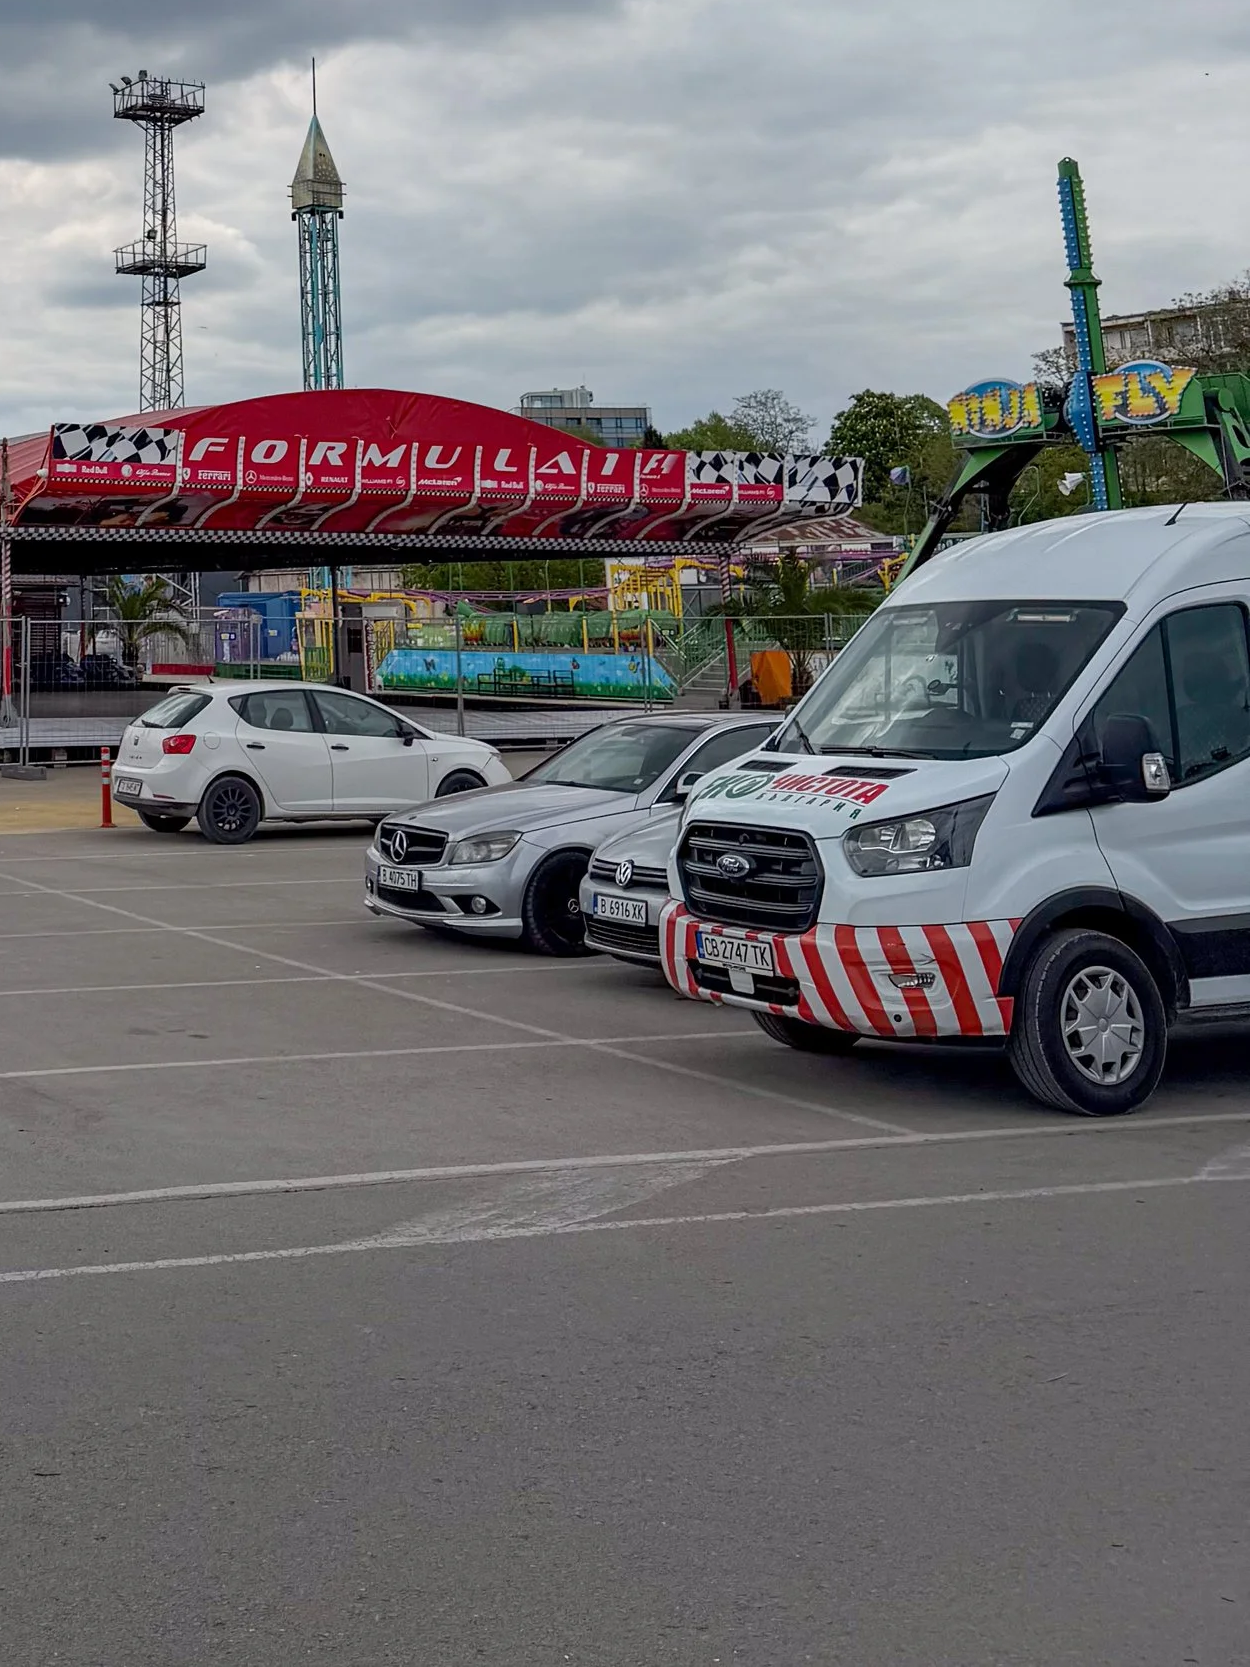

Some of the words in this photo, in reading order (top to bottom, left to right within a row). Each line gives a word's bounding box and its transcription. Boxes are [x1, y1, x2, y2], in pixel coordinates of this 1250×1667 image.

[1091, 365, 1198, 421] FLY
[641, 452, 680, 474] F1
[81, 465, 95, 474] Red
[95, 466, 108, 475] Bull
[197, 470, 231, 481] Ferrari
[321, 476, 348, 484] RENAULT
[417, 478, 459, 486] McLaren
[501, 480, 513, 489] Red
[513, 481, 524, 490] Bull
[596, 483, 626, 494] Ferrari
[691, 487, 727, 495] McLaren
[755, 792, 862, 820] БЪЛГАРИЯ
[405, 872, 417, 888] TH
[600, 898, 607, 914] B
[609, 899, 630, 918] 6916
[631, 903, 644, 921] XK
[704, 937, 719, 957] CB
[720, 940, 748, 963] 2747
[751, 943, 770, 967] TK
